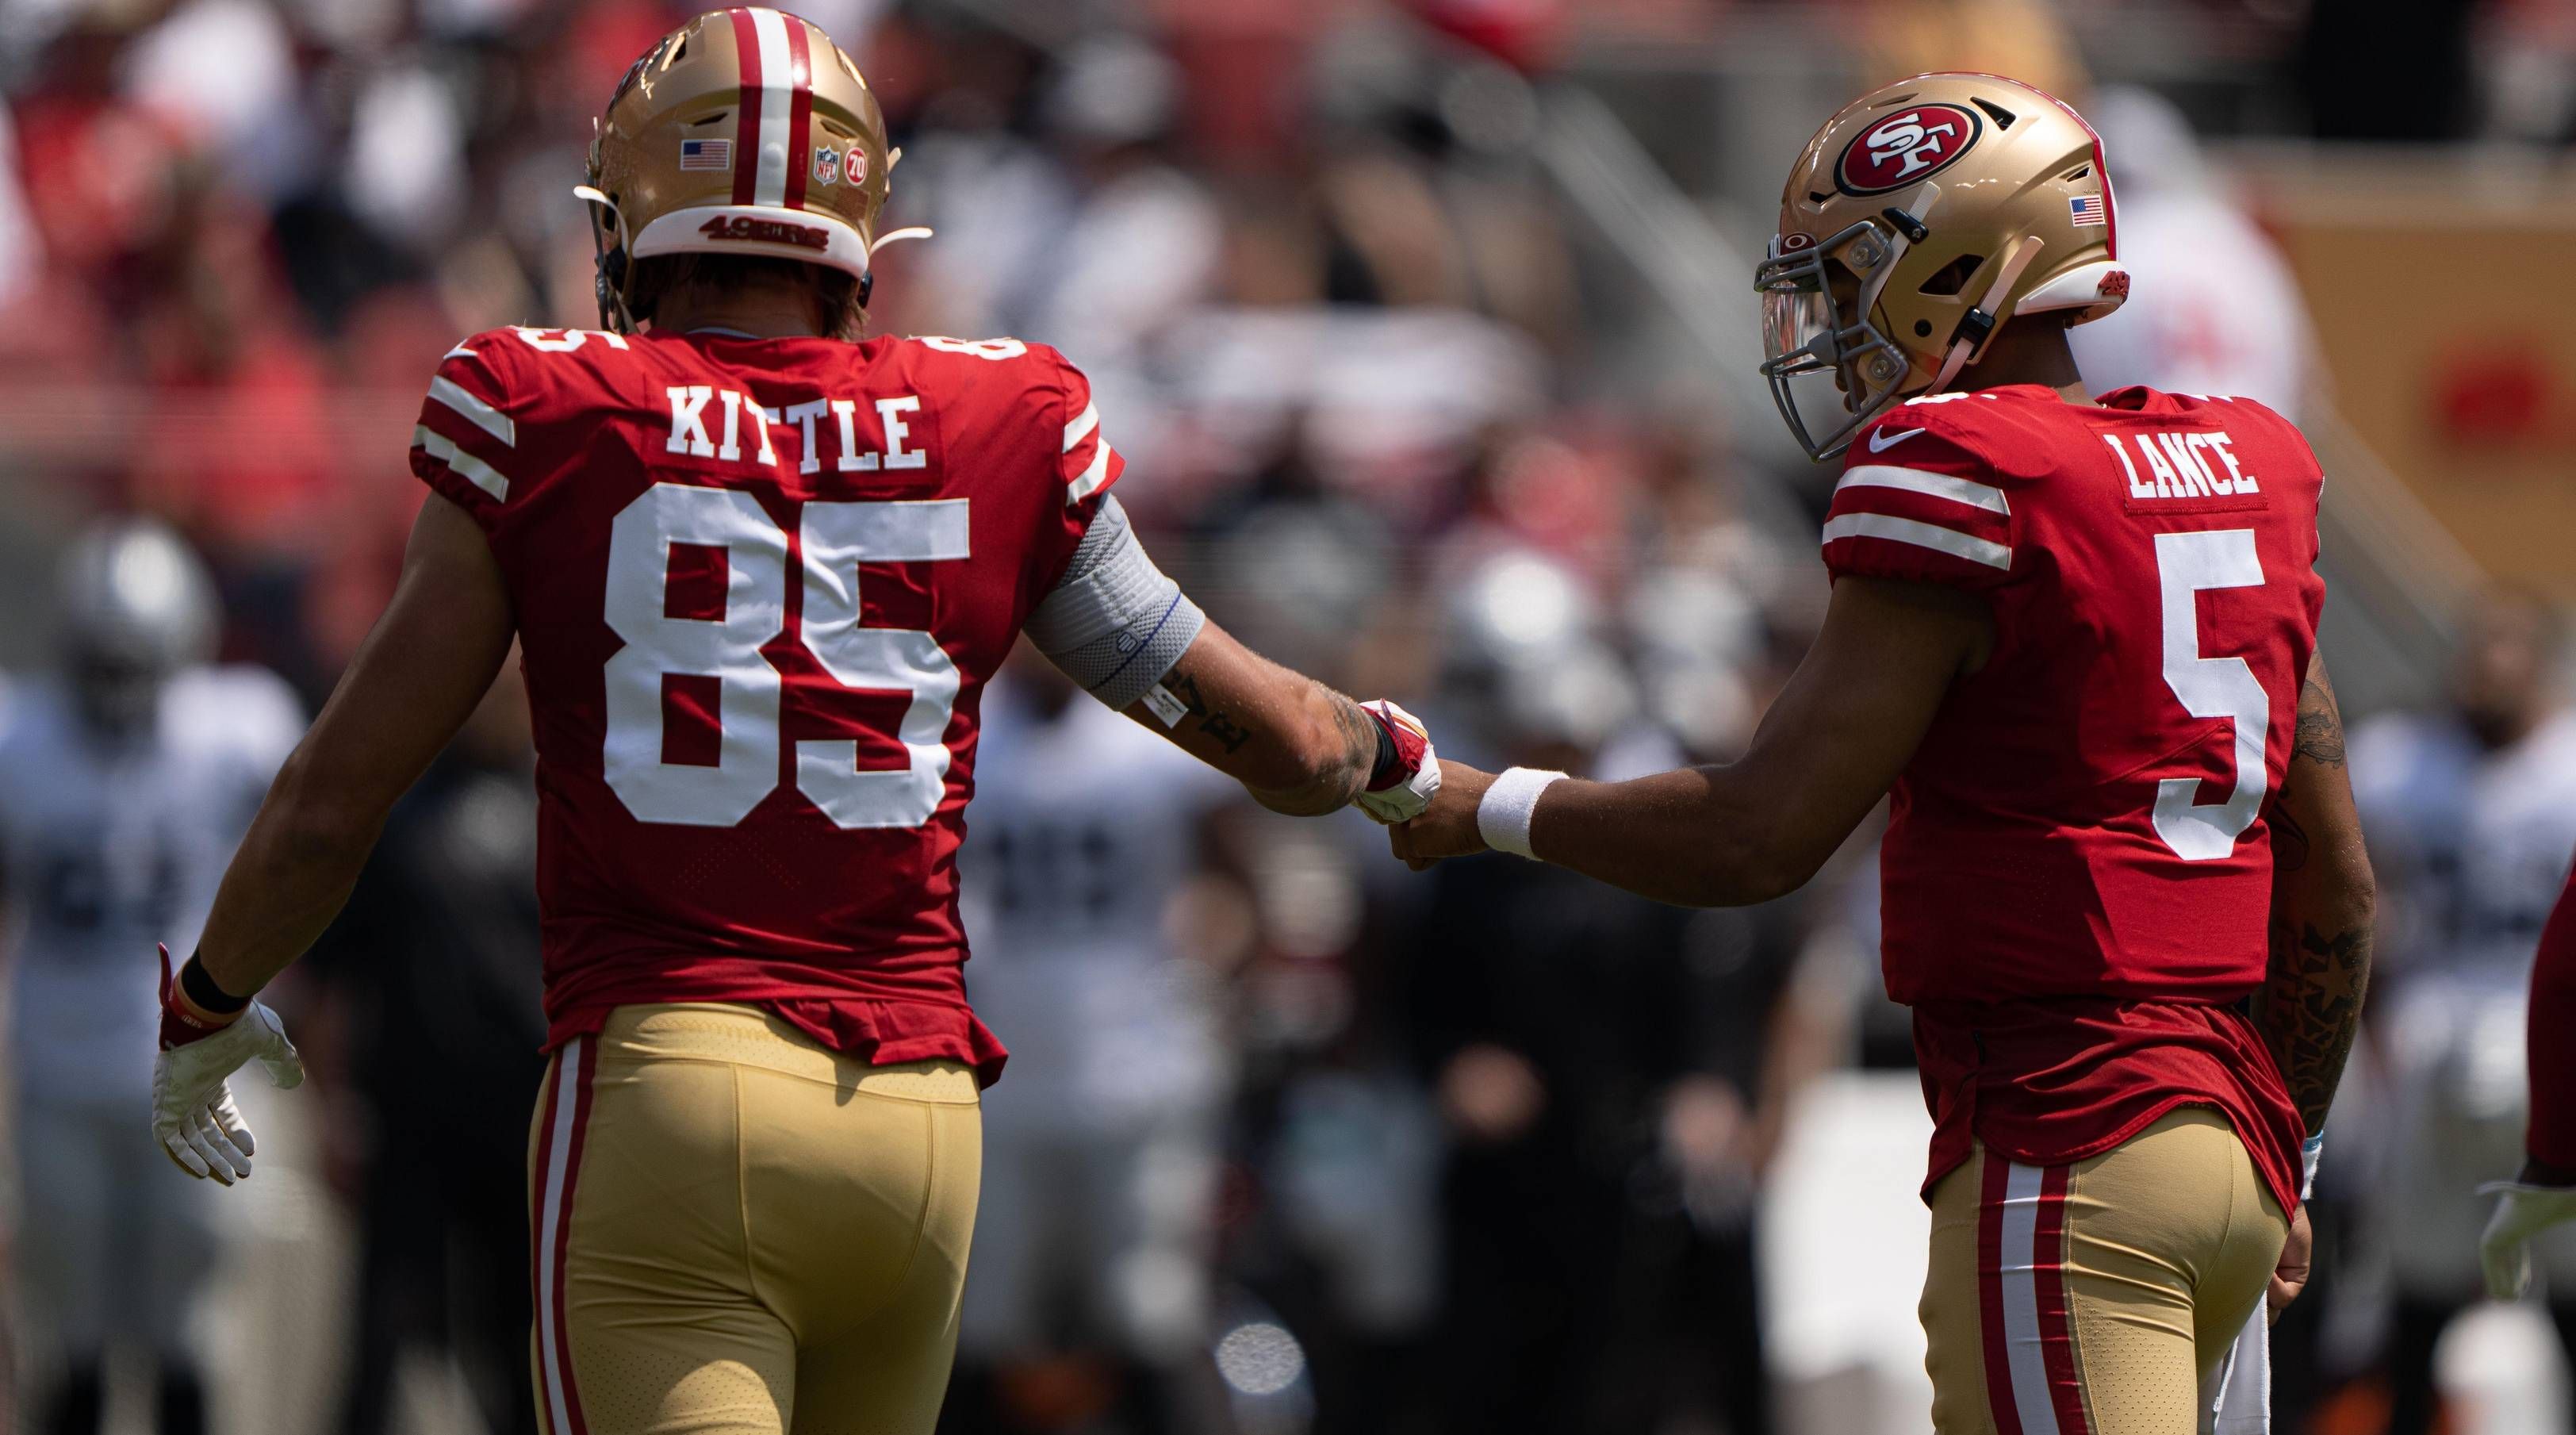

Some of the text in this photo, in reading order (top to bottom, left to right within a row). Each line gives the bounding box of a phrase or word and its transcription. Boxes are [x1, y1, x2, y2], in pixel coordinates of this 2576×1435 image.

[815, 161, 838, 180] NFL
[849, 153, 866, 179] 70
[1866, 112, 1956, 178] SF
[665, 386, 927, 474] KITTLE
[2103, 431, 2260, 499] LANCE
[604, 481, 971, 830] 85
[2152, 528, 2269, 861] 5
